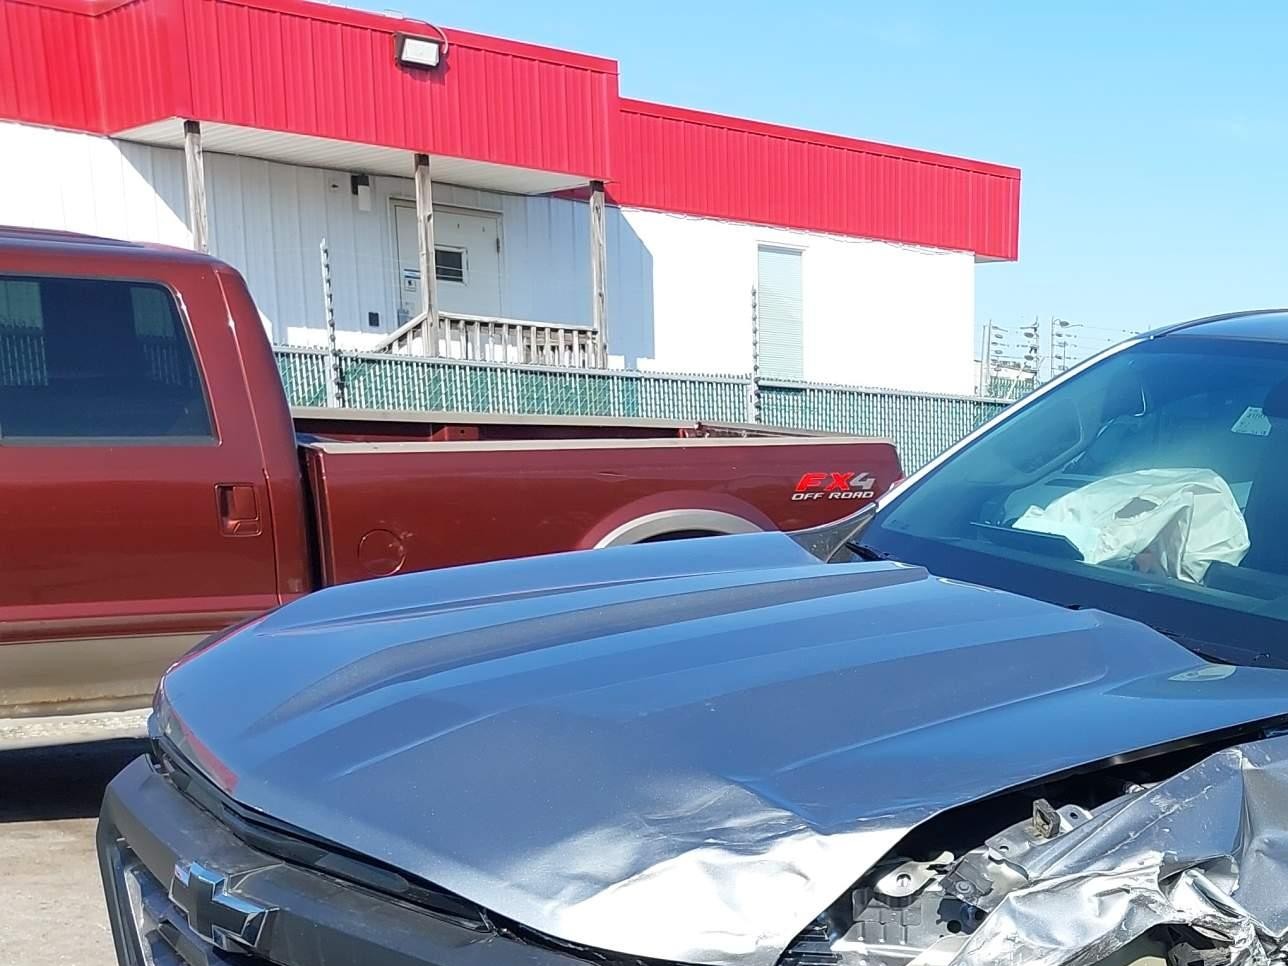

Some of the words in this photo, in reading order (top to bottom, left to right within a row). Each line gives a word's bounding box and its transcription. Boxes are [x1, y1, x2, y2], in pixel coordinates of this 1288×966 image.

[795, 472, 876, 491] FX4
[791, 493, 824, 501] OFF
[828, 491, 875, 499] ROAD
